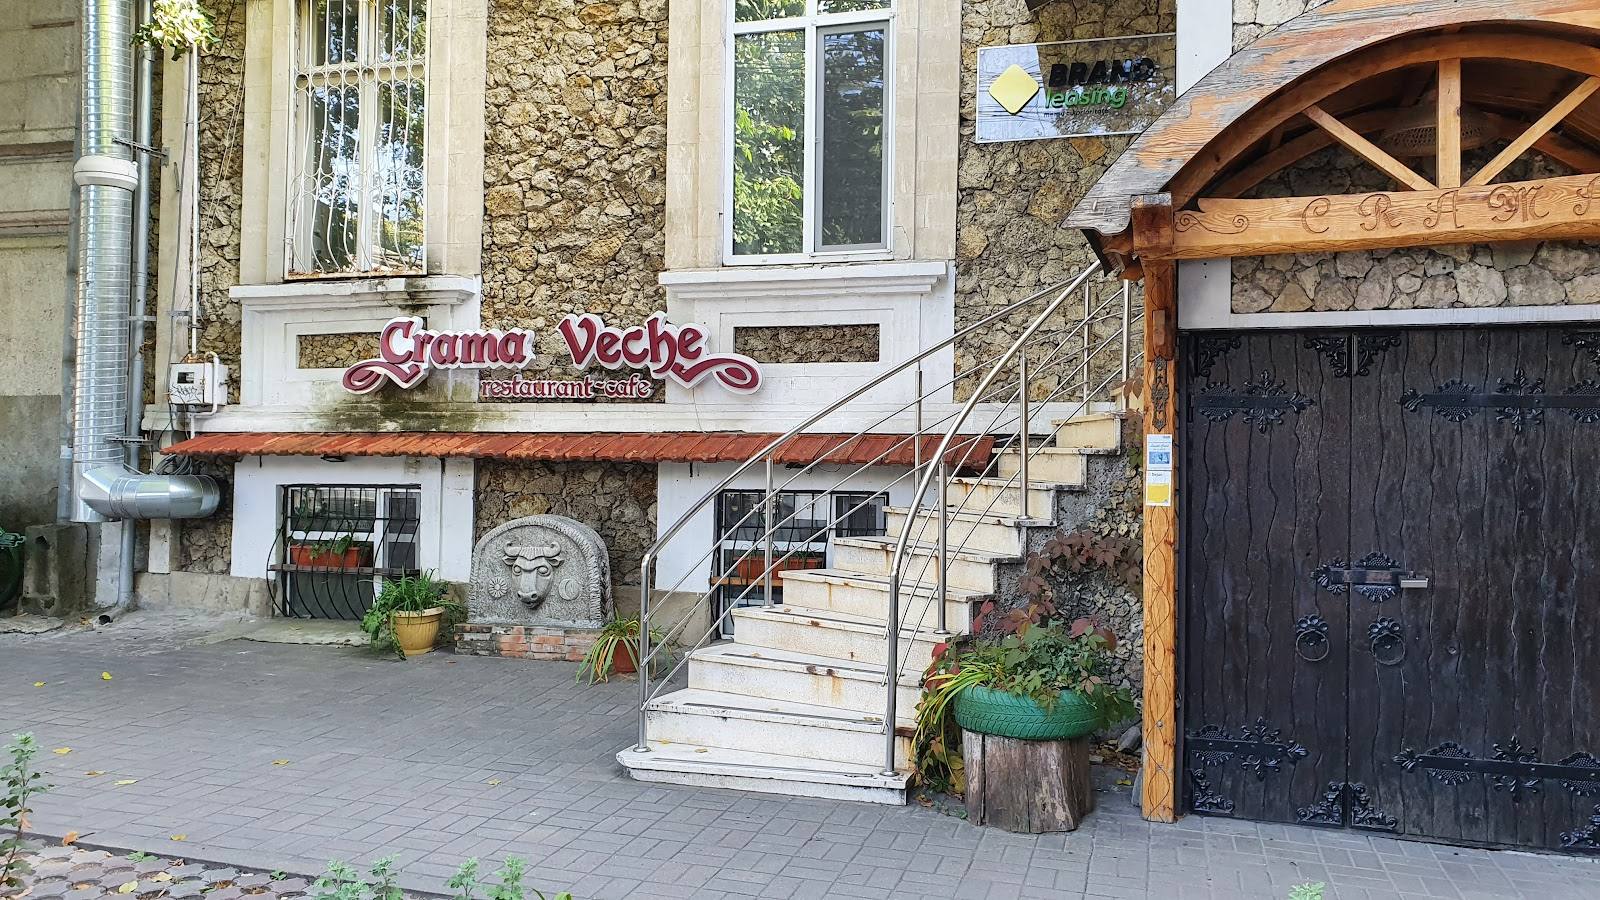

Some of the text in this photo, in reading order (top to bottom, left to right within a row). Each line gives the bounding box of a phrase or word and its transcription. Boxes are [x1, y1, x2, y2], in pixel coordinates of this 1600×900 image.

[1049, 57, 1155, 87] BRAND
[1045, 86, 1128, 110] leasing
[379, 310, 706, 375] Crama Veche
